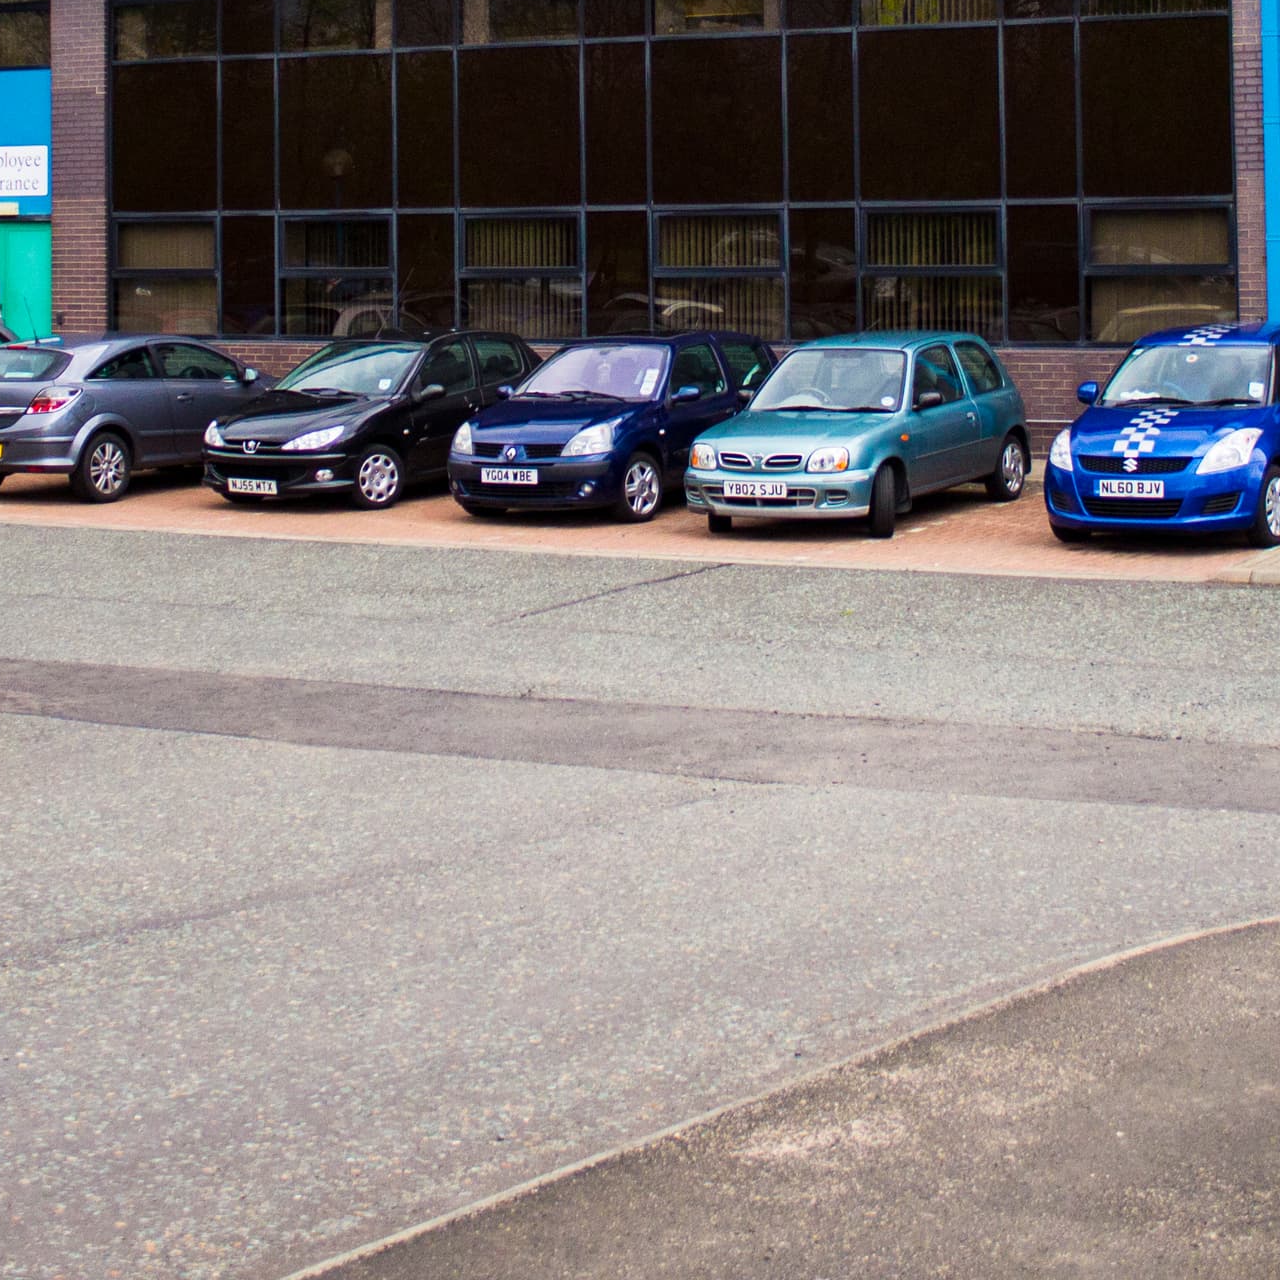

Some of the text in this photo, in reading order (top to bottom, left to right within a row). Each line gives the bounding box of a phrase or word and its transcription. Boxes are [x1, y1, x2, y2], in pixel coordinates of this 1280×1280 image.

[485, 469, 532, 482] YG04 WBE
[231, 479, 254, 491] NJ55
[728, 482, 783, 496] YB02 SJU
[1101, 481, 1161, 494] NL60 BJV
